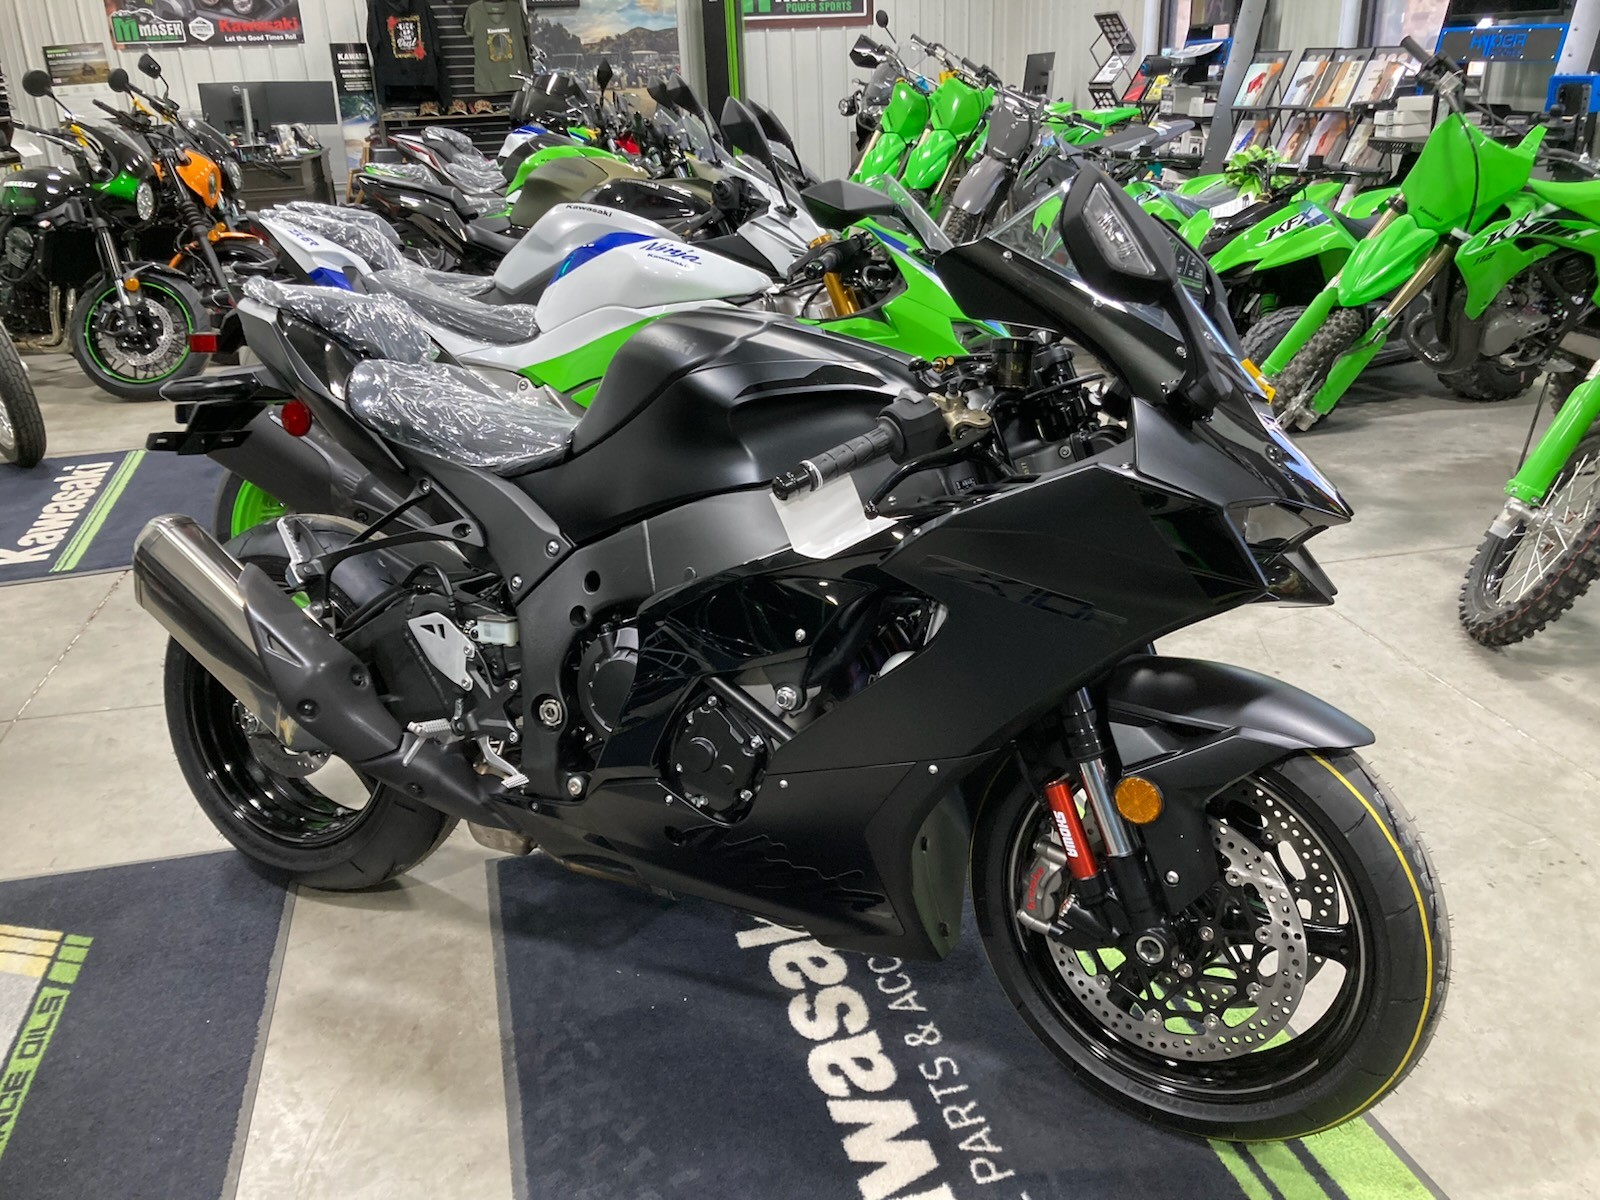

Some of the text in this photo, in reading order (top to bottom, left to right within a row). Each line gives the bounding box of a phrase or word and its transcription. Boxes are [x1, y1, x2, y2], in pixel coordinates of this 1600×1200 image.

[785, 1, 852, 13] POWER SPORTS
[138, 23, 182, 37] MASEK
[218, 16, 299, 32] Kawasaki
[224, 34, 235, 42] Let
[236, 34, 246, 42] the
[265, 33, 284, 41] Times
[619, 179, 660, 190] Kawasaki
[566, 204, 613, 218] Kawasaki
[1418, 206, 1443, 222] Kawasaki
[1265, 205, 1317, 242] KFX
[1483, 212, 1533, 248] KX
[639, 241, 702, 265] Ninja
[646, 253, 688, 268] Kawasaki
[0, 461, 114, 566] Kawasaki
[1052, 810, 1079, 858] SHOWA
[16, 994, 62, 1060] OILS
[904, 1020, 943, 1047] &
[918, 1055, 1015, 1185] PARTS
